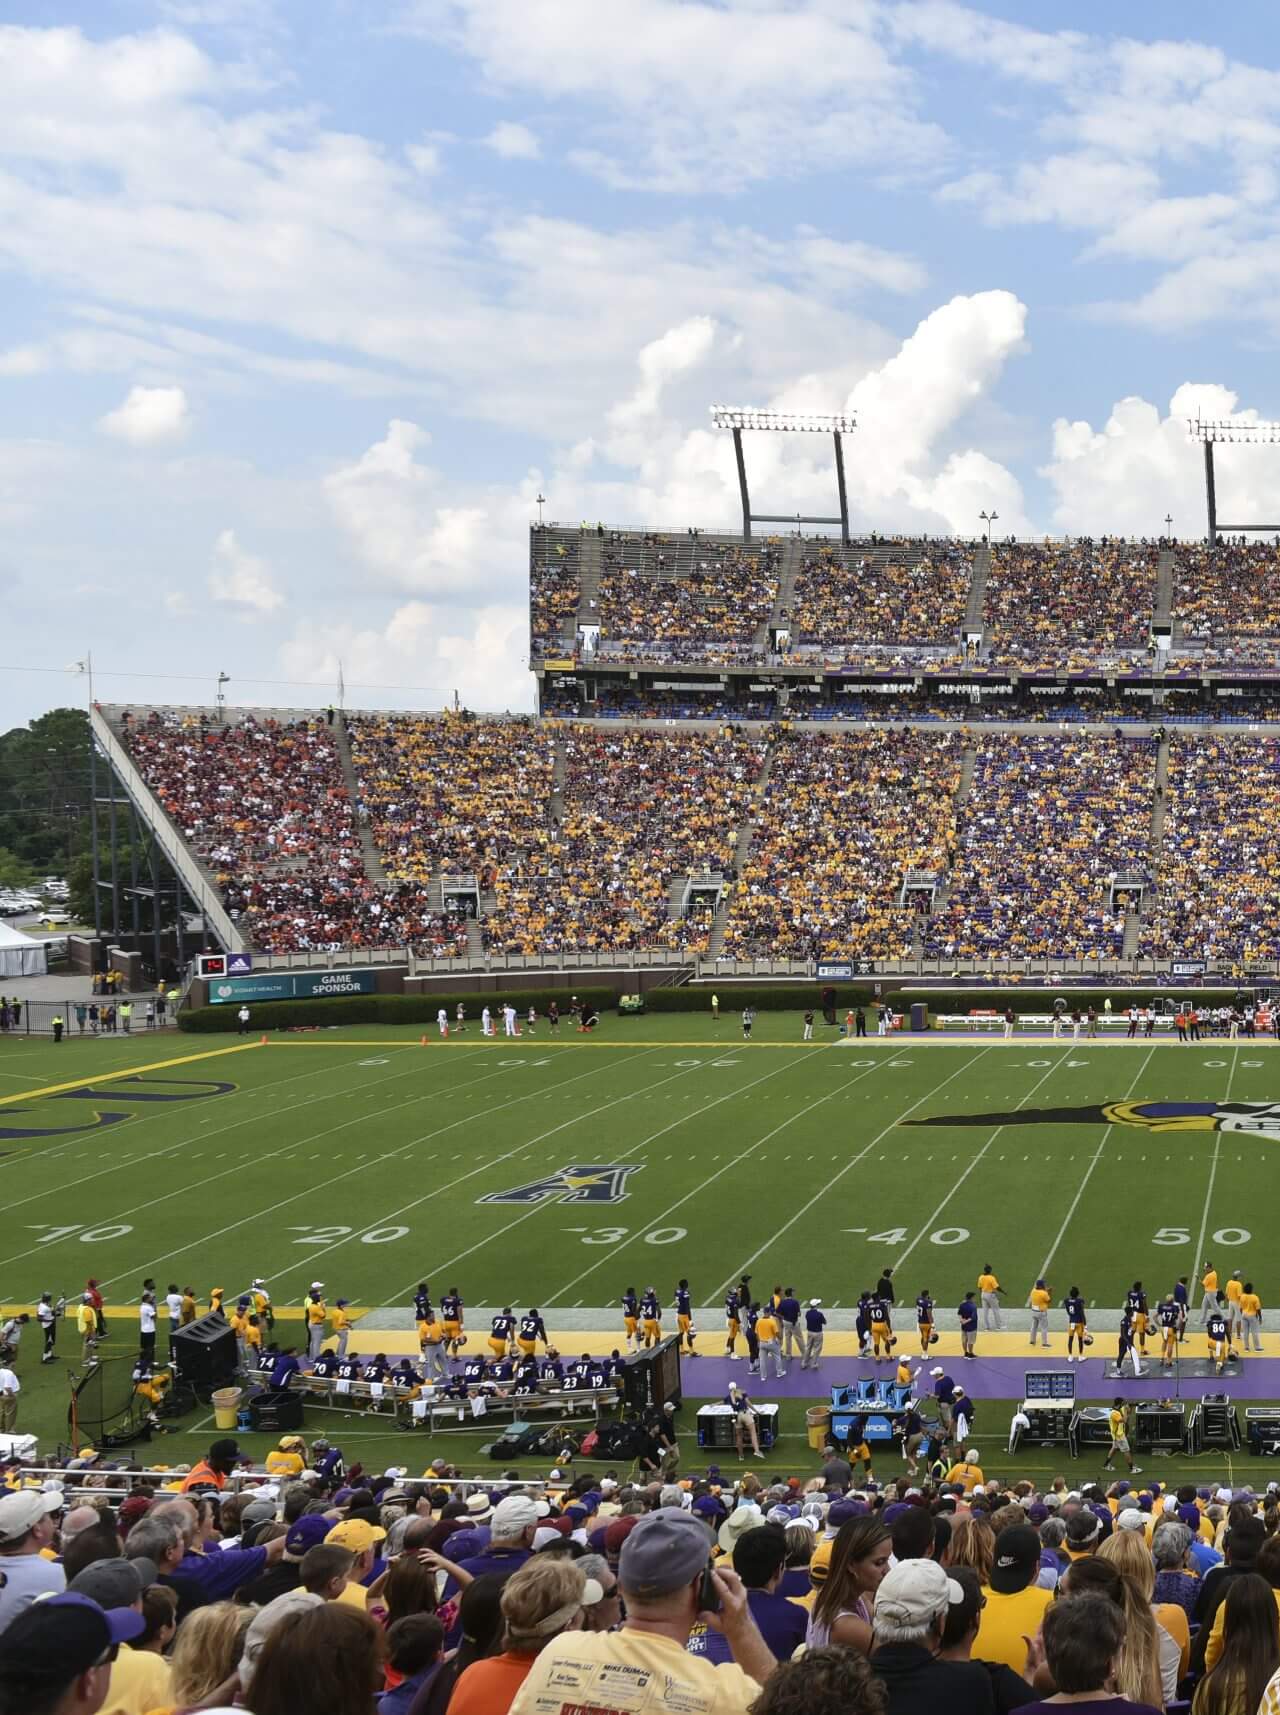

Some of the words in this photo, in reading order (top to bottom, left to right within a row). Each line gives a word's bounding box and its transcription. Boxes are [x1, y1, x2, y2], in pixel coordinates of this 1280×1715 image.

[321, 975, 352, 984] GAME
[312, 983, 361, 994] SPONSOR
[35, 1225, 135, 1243] 10
[293, 1226, 411, 1245] 20
[581, 1227, 689, 1245] 30
[866, 1227, 971, 1246] 40
[1151, 1227, 1252, 1246] 50
[494, 1319, 507, 1330] 73
[521, 1321, 536, 1333] 52
[1212, 1322, 1225, 1334] 80
[259, 1357, 275, 1369] 74
[313, 1362, 328, 1375] 70
[465, 1365, 480, 1376] 86
[563, 1376, 578, 1389] 23
[591, 1375, 604, 1388] 19
[602, 1664, 622, 1674] MIKE
[622, 1666, 650, 1678] DUMAN
